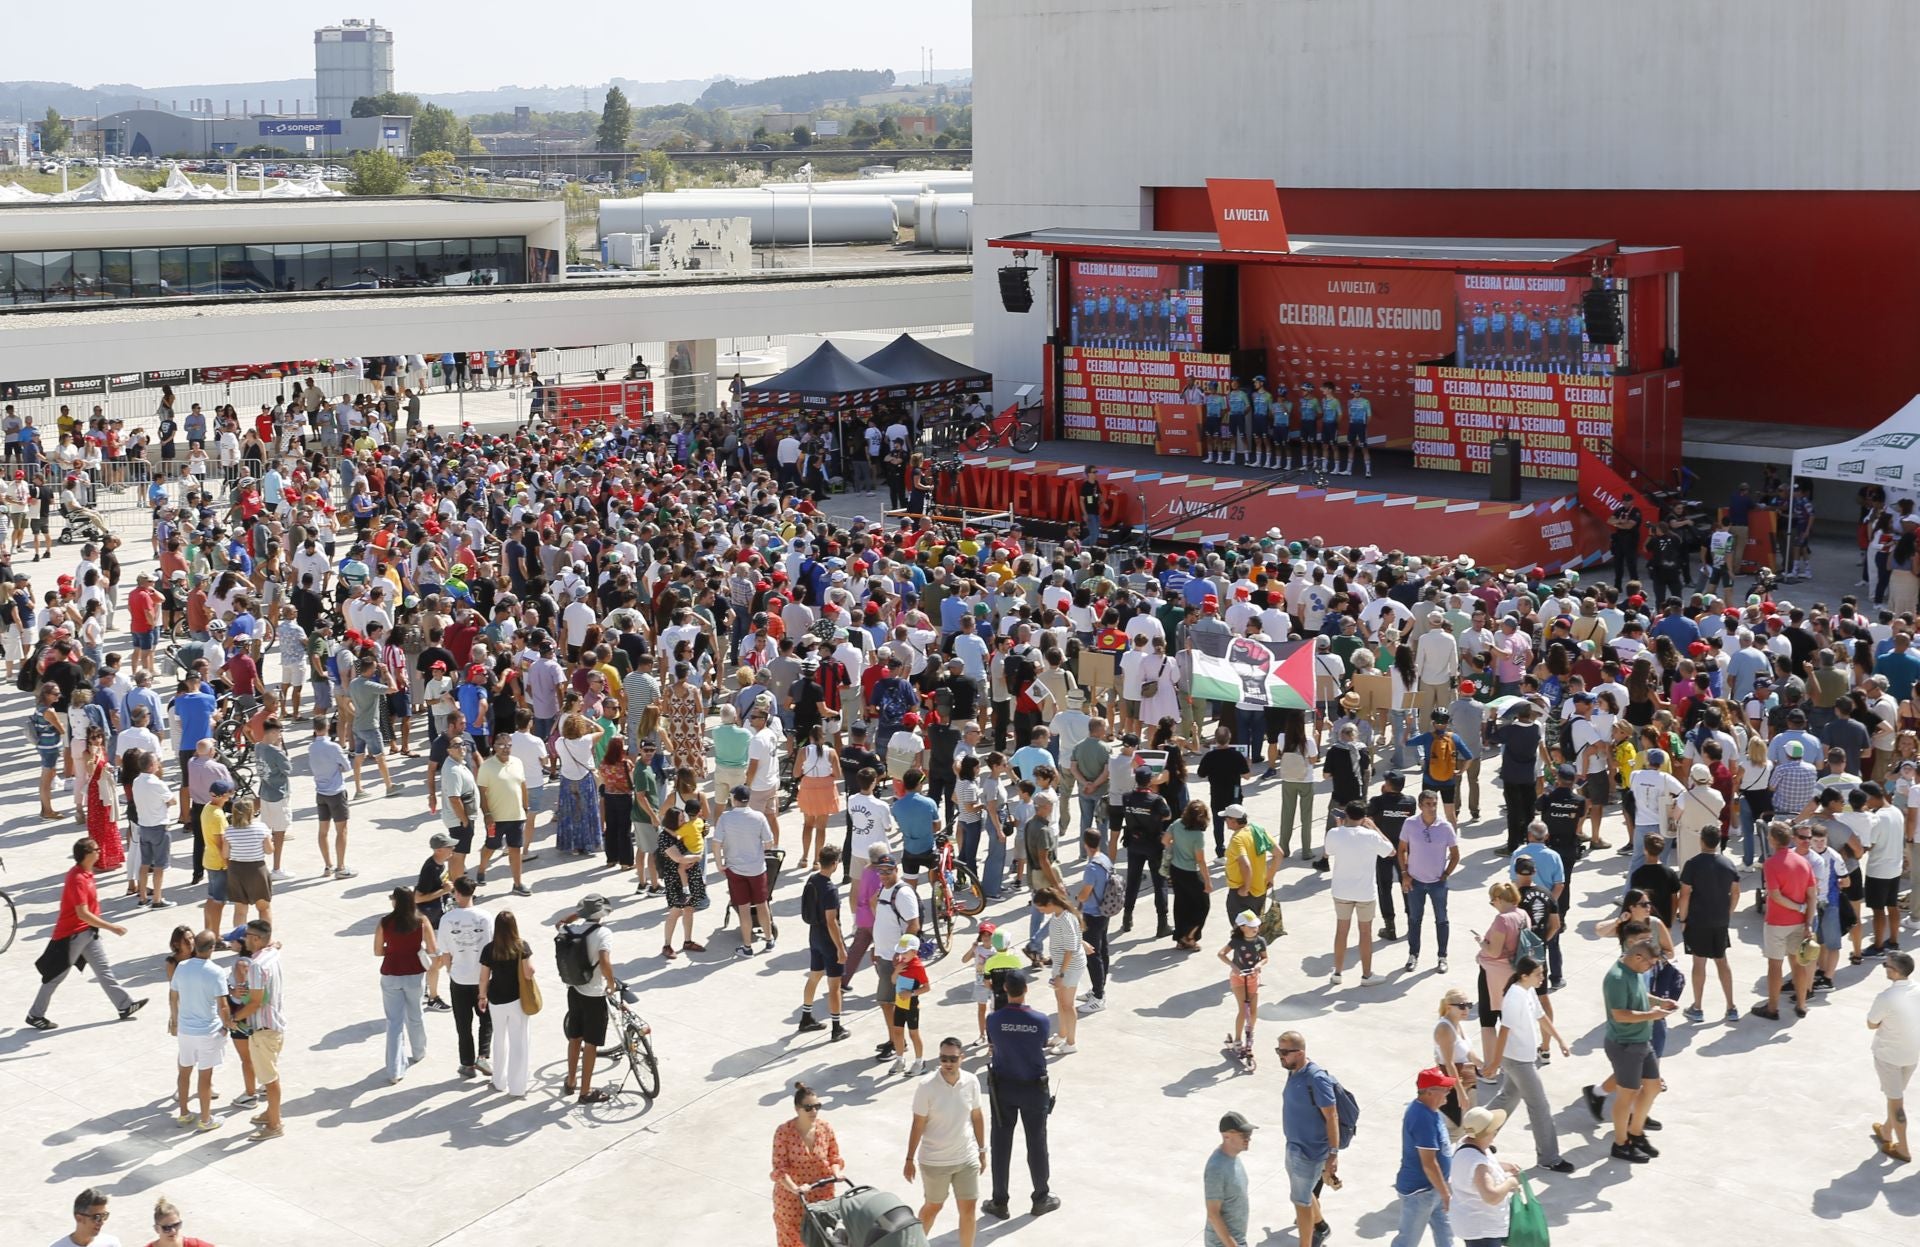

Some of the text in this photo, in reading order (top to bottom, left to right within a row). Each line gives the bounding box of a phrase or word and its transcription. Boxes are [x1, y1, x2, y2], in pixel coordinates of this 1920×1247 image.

[287, 123, 324, 132] sonepar
[1224, 208, 1269, 222] LA VUELTA
[1078, 262, 1158, 278] CELEBRA CADA SEGUNDO
[1328, 281, 1339, 293] LA
[1341, 281, 1376, 294] VUELTA
[1465, 275, 1565, 291] CELEBRA CADA SEGUNDO
[1279, 303, 1442, 330] CELEBRA CADA SEGUNDO
[1082, 347, 1114, 358] CELEBRA
[1115, 349, 1134, 359] CADA
[1136, 350, 1170, 361] SEGUNDO
[1180, 352, 1213, 364] CELEBRA
[159, 370, 186, 378] TISSOT
[1087, 359, 1118, 373] CELEBRA
[1119, 361, 1138, 374] CADA
[1140, 362, 1175, 376] SEGUNDO
[1184, 365, 1217, 379] CELEBRA
[1438, 367, 1476, 380] CELEBRA
[1479, 369, 1502, 381] CADA
[1504, 371, 1547, 384] SEGUNDO
[1559, 374, 1600, 387] CELEBRA
[72, 380, 101, 388] TISSOT
[1091, 374, 1122, 387] CELEBRA
[1123, 375, 1144, 388] CADA
[1145, 376, 1179, 391] SEGUNDO
[1096, 388, 1127, 402] CELEBRA
[1128, 390, 1148, 403] CADA
[1444, 380, 1482, 396] CELEBRA
[1484, 383, 1508, 398] CADA
[1510, 384, 1553, 400] SEGUNDO
[1565, 387, 1606, 403] CELEBRA
[1100, 403, 1131, 416] CELEBRA
[1133, 404, 1153, 418] CADA
[1449, 396, 1488, 412] CELEBRA
[1490, 399, 1514, 414] CADA
[1516, 400, 1559, 417] SEGUNDO
[1064, 414, 1096, 429] SEGUNDO
[1105, 417, 1136, 431] CELEBRA
[1455, 412, 1494, 428] CELEBRA
[1522, 417, 1565, 433] SEGUNDO
[1110, 431, 1142, 444] CELEBRA
[1528, 433, 1571, 450] SEGUNDO
[1414, 440, 1455, 456] SEGUNDO
[1533, 450, 1577, 467] SEGUNDO
[971, 466, 1083, 523] VUELTA
[1592, 486, 1607, 502] LA
[1169, 499, 1184, 514] LA
[1229, 506, 1246, 520] 25
[1001, 1023, 1038, 1033] SEGURIDAD
